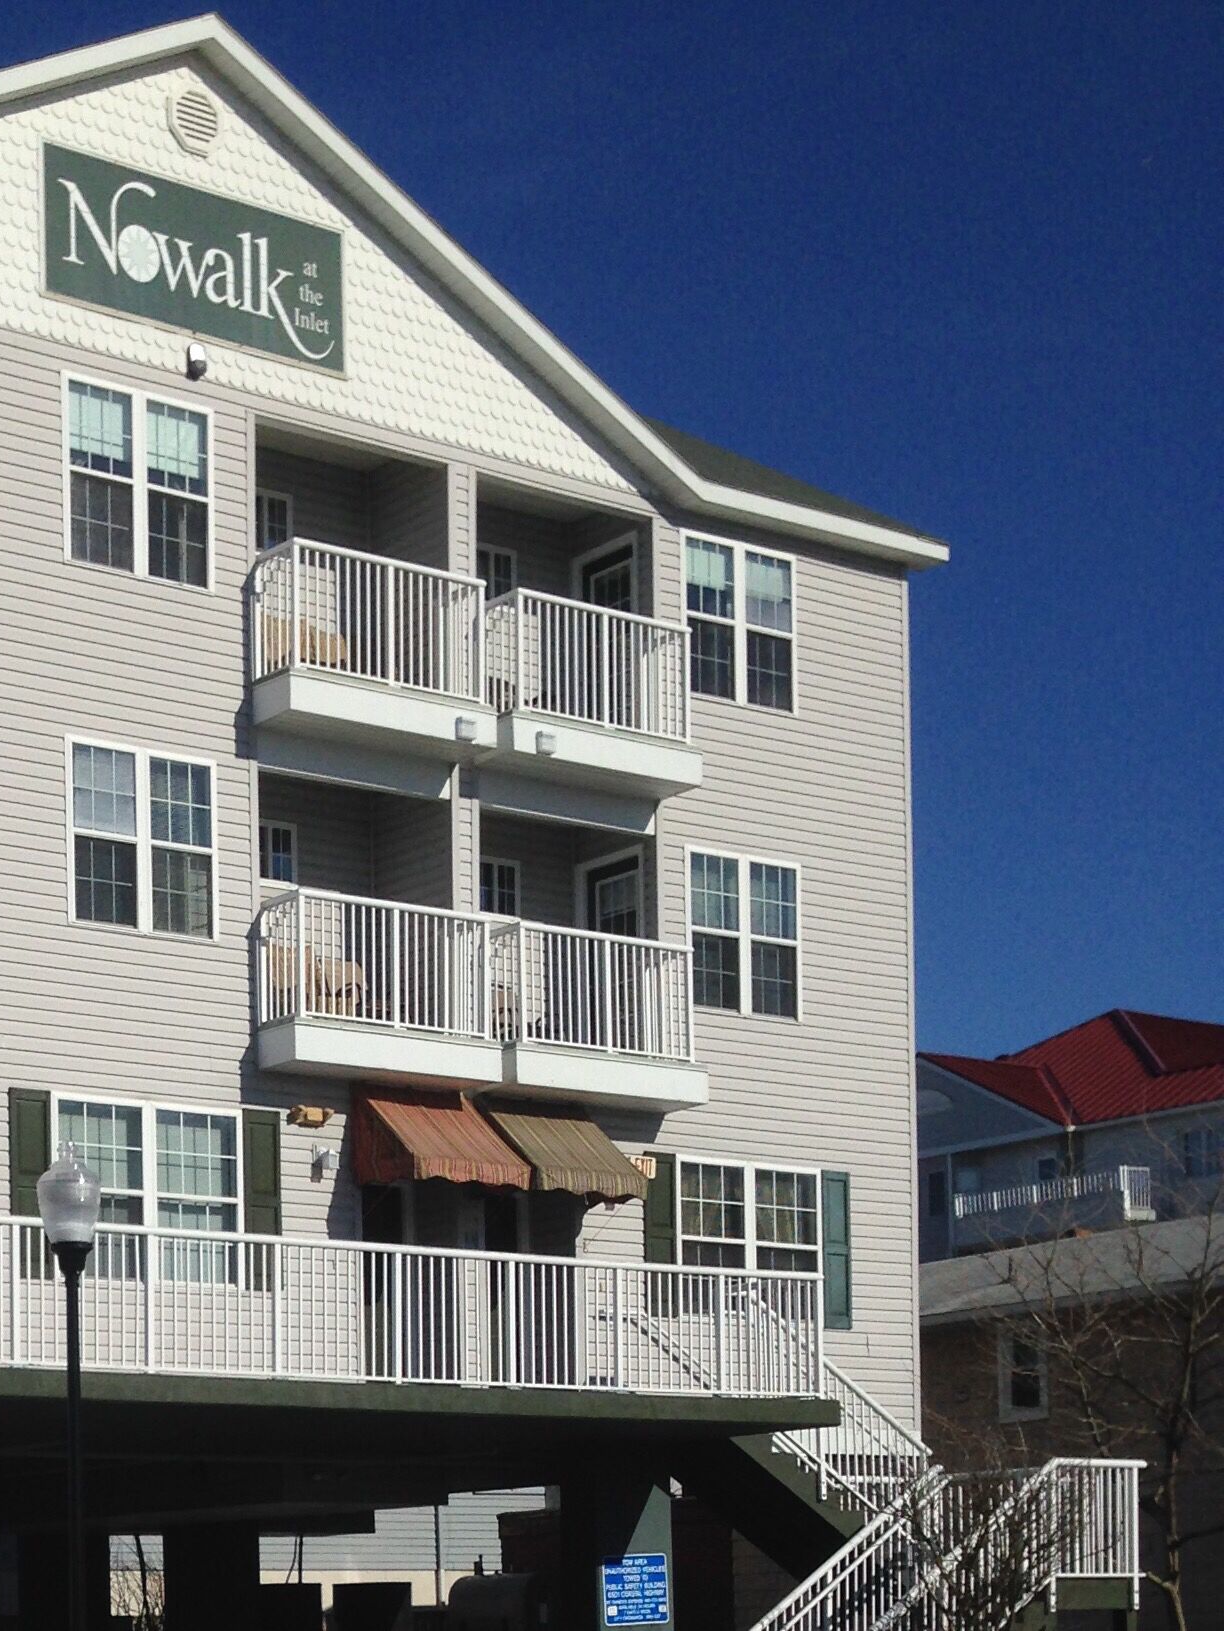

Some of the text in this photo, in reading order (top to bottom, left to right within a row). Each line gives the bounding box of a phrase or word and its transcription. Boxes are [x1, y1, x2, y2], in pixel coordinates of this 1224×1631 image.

[57, 177, 335, 360] Nowalk
[302, 261, 318, 278] at
[299, 283, 324, 307] the
[294, 307, 330, 334] Inlet
